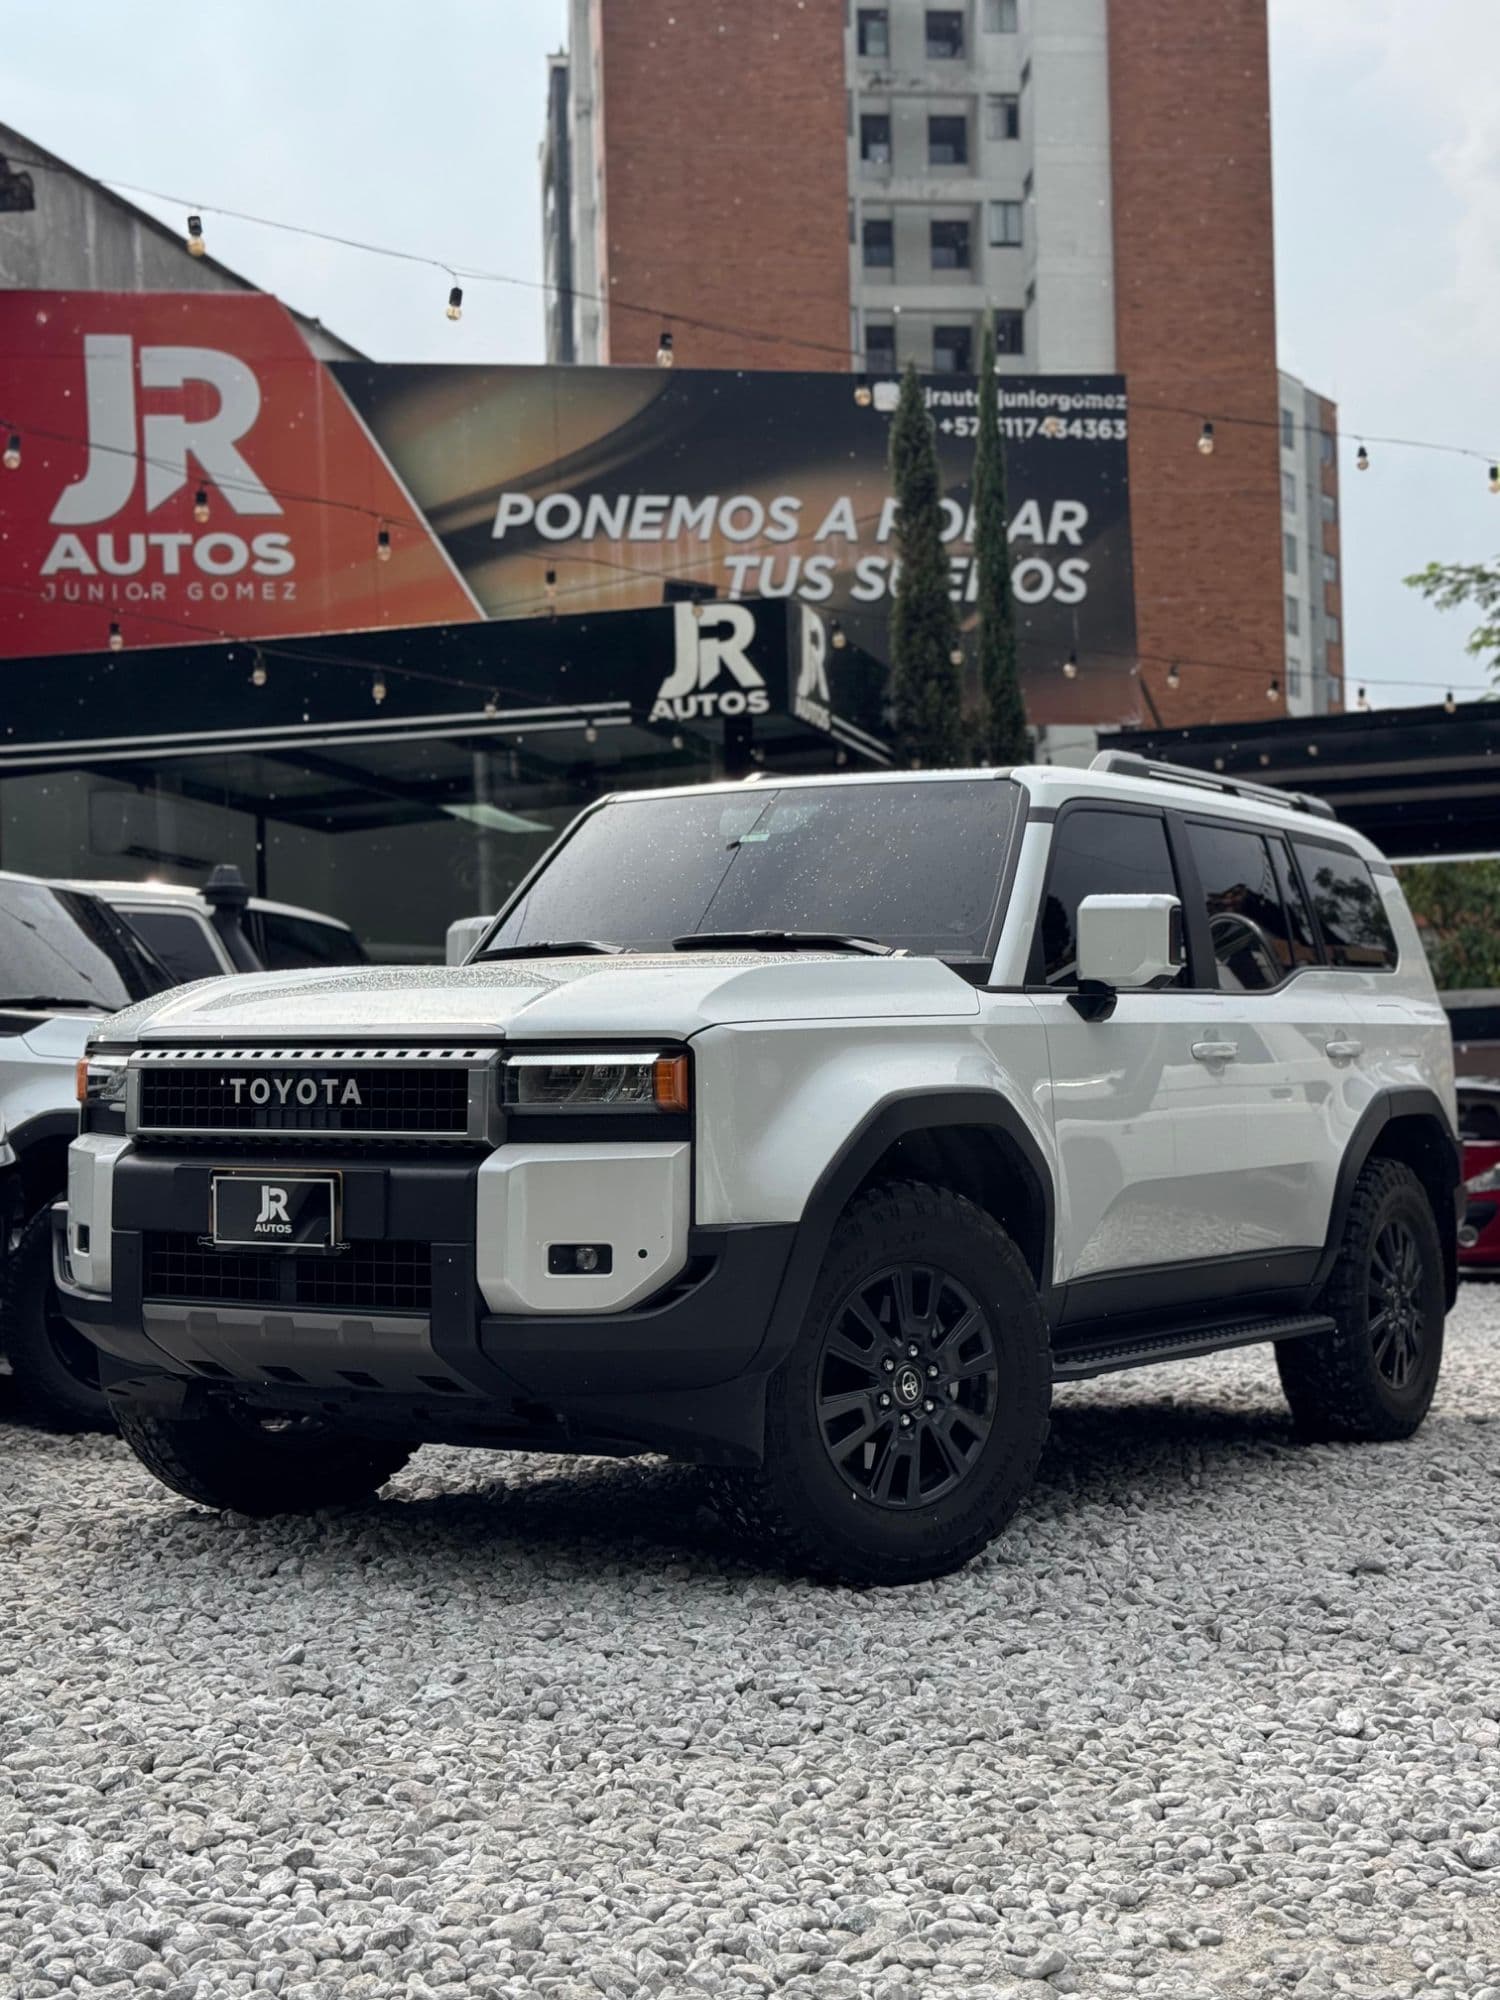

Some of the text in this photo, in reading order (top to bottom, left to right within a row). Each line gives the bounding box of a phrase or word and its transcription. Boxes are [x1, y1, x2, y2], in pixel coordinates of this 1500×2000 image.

[49, 334, 285, 526] JR
[492, 493, 803, 543] PONEMOS
[815, 497, 858, 542] A
[39, 533, 296, 576] AUTOS
[42, 582, 297, 601] JUNIOR GOMEZ
[723, 555, 834, 601] TUS
[657, 602, 766, 698] JR
[648, 689, 770, 723] AUTOS
[229, 1077, 362, 1105] TOYOTA
[256, 1185, 290, 1222] JR
[254, 1223, 292, 1234] AUTOS
